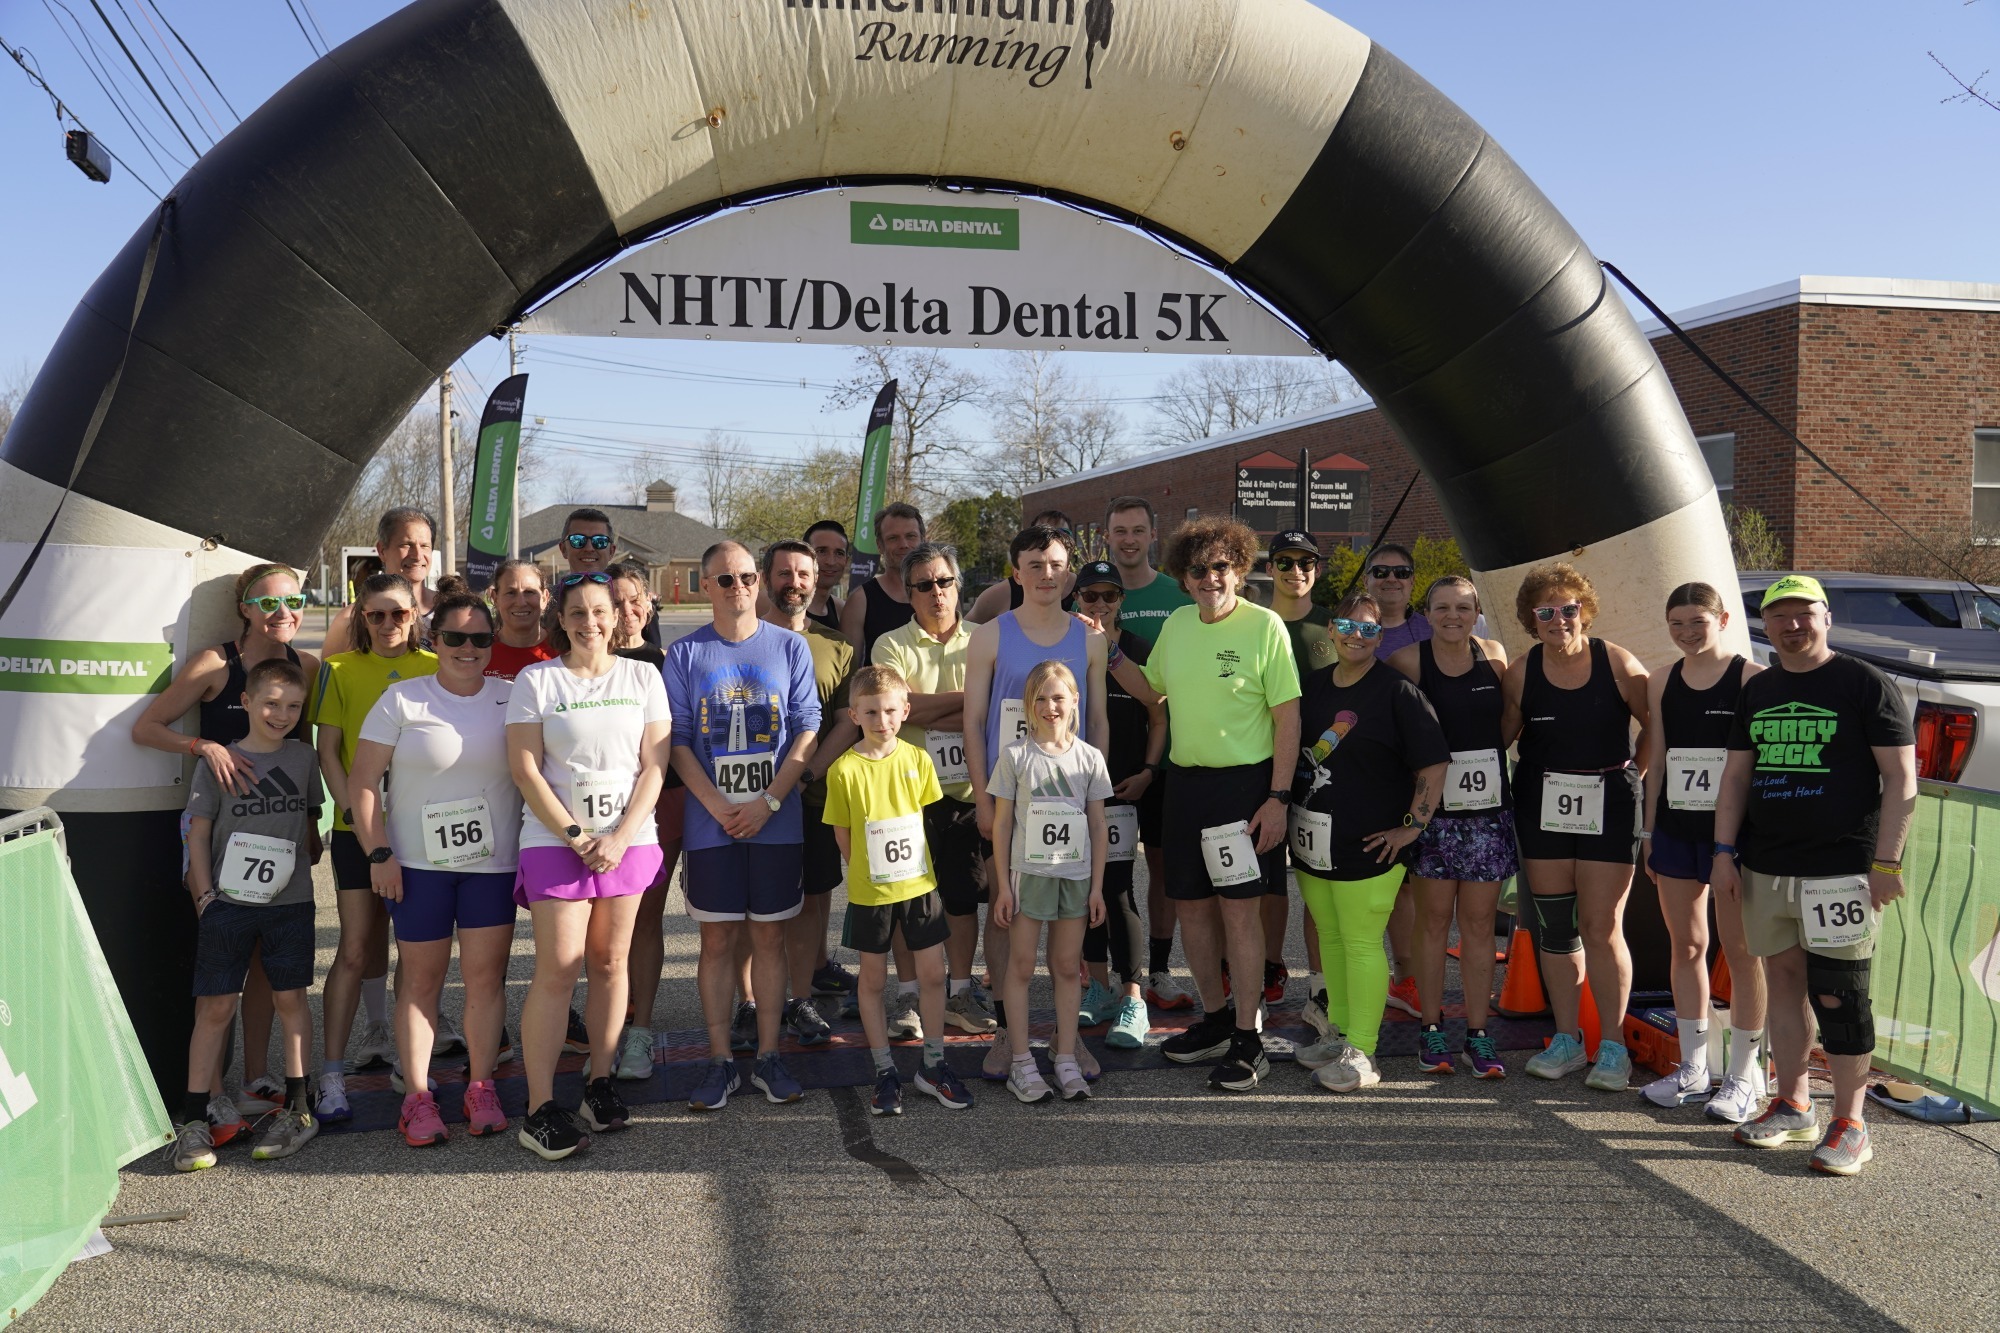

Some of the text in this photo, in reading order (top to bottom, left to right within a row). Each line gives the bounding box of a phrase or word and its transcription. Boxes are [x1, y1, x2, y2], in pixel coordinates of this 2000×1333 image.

[855, 21, 1072, 88] Running
[892, 218, 1001, 235] DELTA DENTAL
[968, 286, 1139, 341] Dental
[1156, 292, 1229, 342] 5K
[485, 436, 504, 522] DELTA DENTAL
[1238, 480, 1298, 490] Child & Family Center
[1310, 482, 1347, 490] Farnum Hall
[1238, 490, 1255, 498] Little
[1242, 498, 1296, 508] Capital Commons
[1310, 492, 1353, 501] Grappone Hall
[863, 489, 873, 523] DELTA
[1310, 502, 1338, 511] MacRury
[1120, 611, 1139, 620] ELTA
[0, 657, 148, 677] DELTA DENTAL
[570, 698, 641, 710] DELTA DENTAL
[718, 760, 774, 794] 4260
[1459, 770, 1487, 793] 49
[1681, 769, 1711, 792] 74
[1765, 774, 1788, 786] Loud.
[1763, 786, 1824, 799] Lounge Hard.
[231, 795, 305, 818] adidas
[427, 812, 441, 820] NHTI
[460, 806, 477, 815] Dental
[583, 792, 626, 818] 154
[1558, 794, 1583, 816] 91
[434, 819, 483, 849] 156
[1042, 823, 1071, 846] 64
[1107, 824, 1120, 845] 6
[1297, 826, 1313, 851] 51
[252, 843, 267, 851] Delta
[267, 846, 286, 854] Dental
[884, 837, 913, 864] 65
[1218, 845, 1234, 868] 5
[242, 856, 276, 884] 76
[1838, 886, 1858, 894] Dental
[1812, 899, 1865, 928] 136
